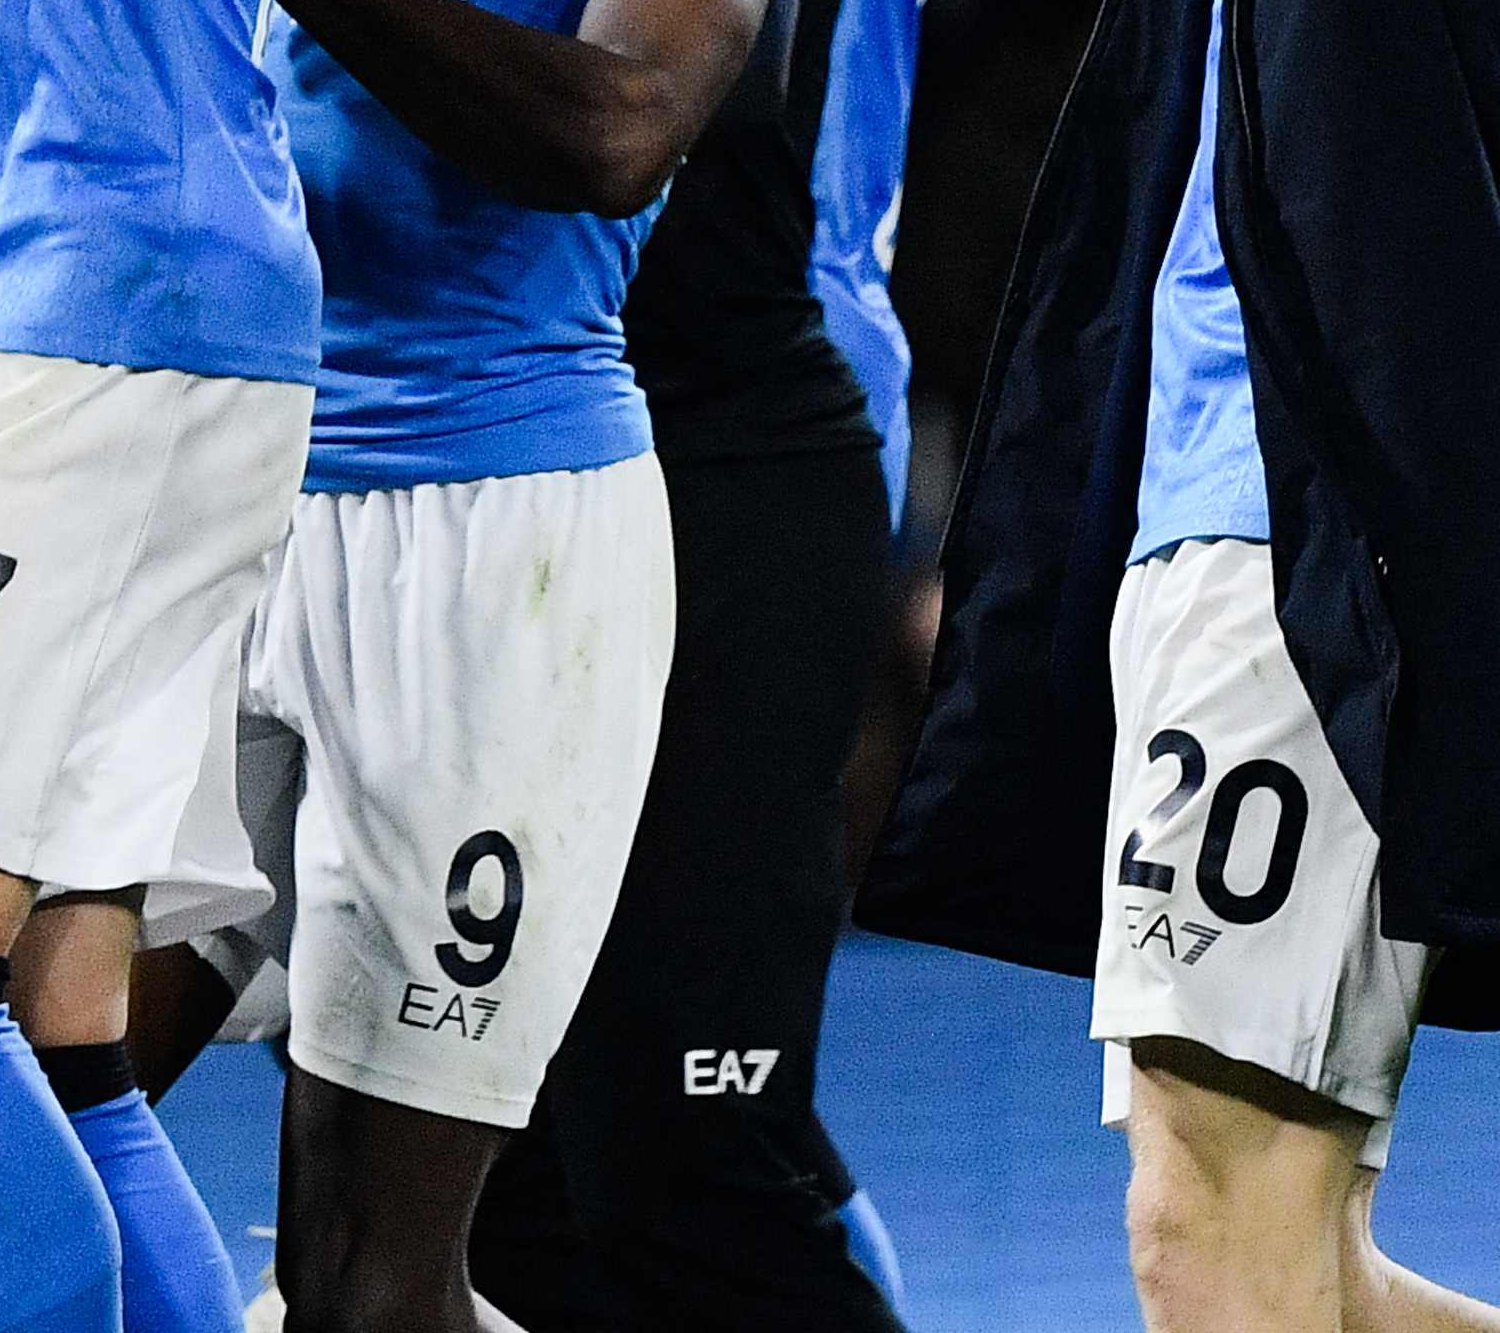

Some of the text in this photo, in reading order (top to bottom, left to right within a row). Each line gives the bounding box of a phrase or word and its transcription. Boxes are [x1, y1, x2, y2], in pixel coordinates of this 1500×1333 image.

[1118, 728, 1310, 926] 20
[436, 829, 524, 988] 9
[398, 982, 501, 1042] EA7
[683, 1048, 780, 1096] EA7
